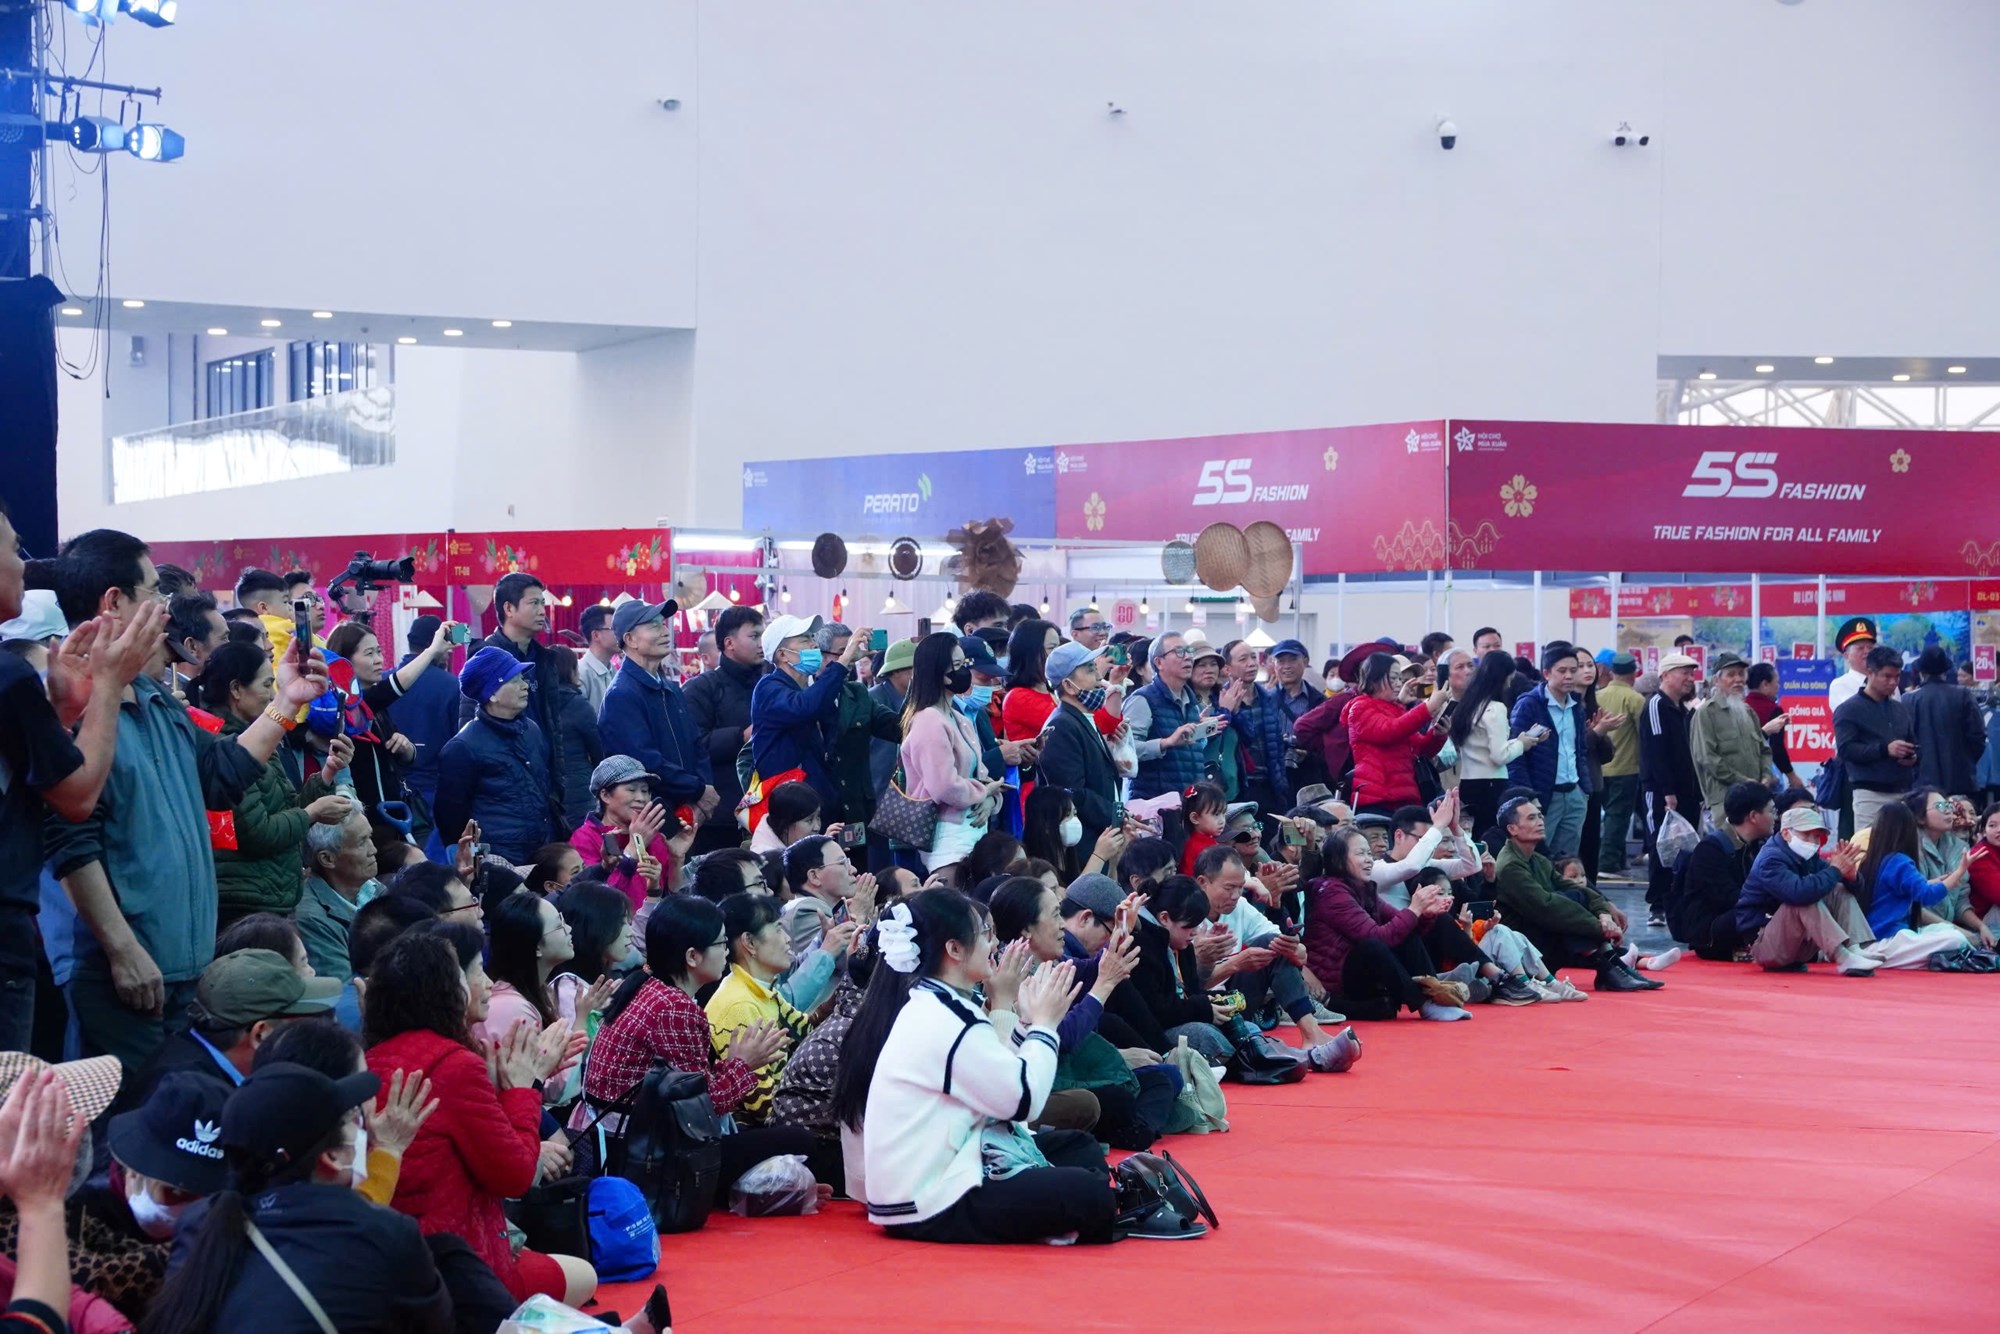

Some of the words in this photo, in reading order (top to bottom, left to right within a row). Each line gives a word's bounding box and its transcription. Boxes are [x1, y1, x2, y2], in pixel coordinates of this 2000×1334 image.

[1192, 458, 1253, 506] 5S
[1253, 484, 1309, 502] FASHION
[1681, 451, 1779, 498] 5S
[1779, 482, 1866, 500] FASHION
[864, 493, 920, 514] PERATO
[1653, 525, 1692, 540] TRUE
[1694, 526, 1760, 541] FASHION
[1763, 526, 1794, 542] FOR
[1796, 527, 1823, 542] ALL
[1826, 528, 1882, 544] FAMILY
[176, 1137, 224, 1160] adidas
